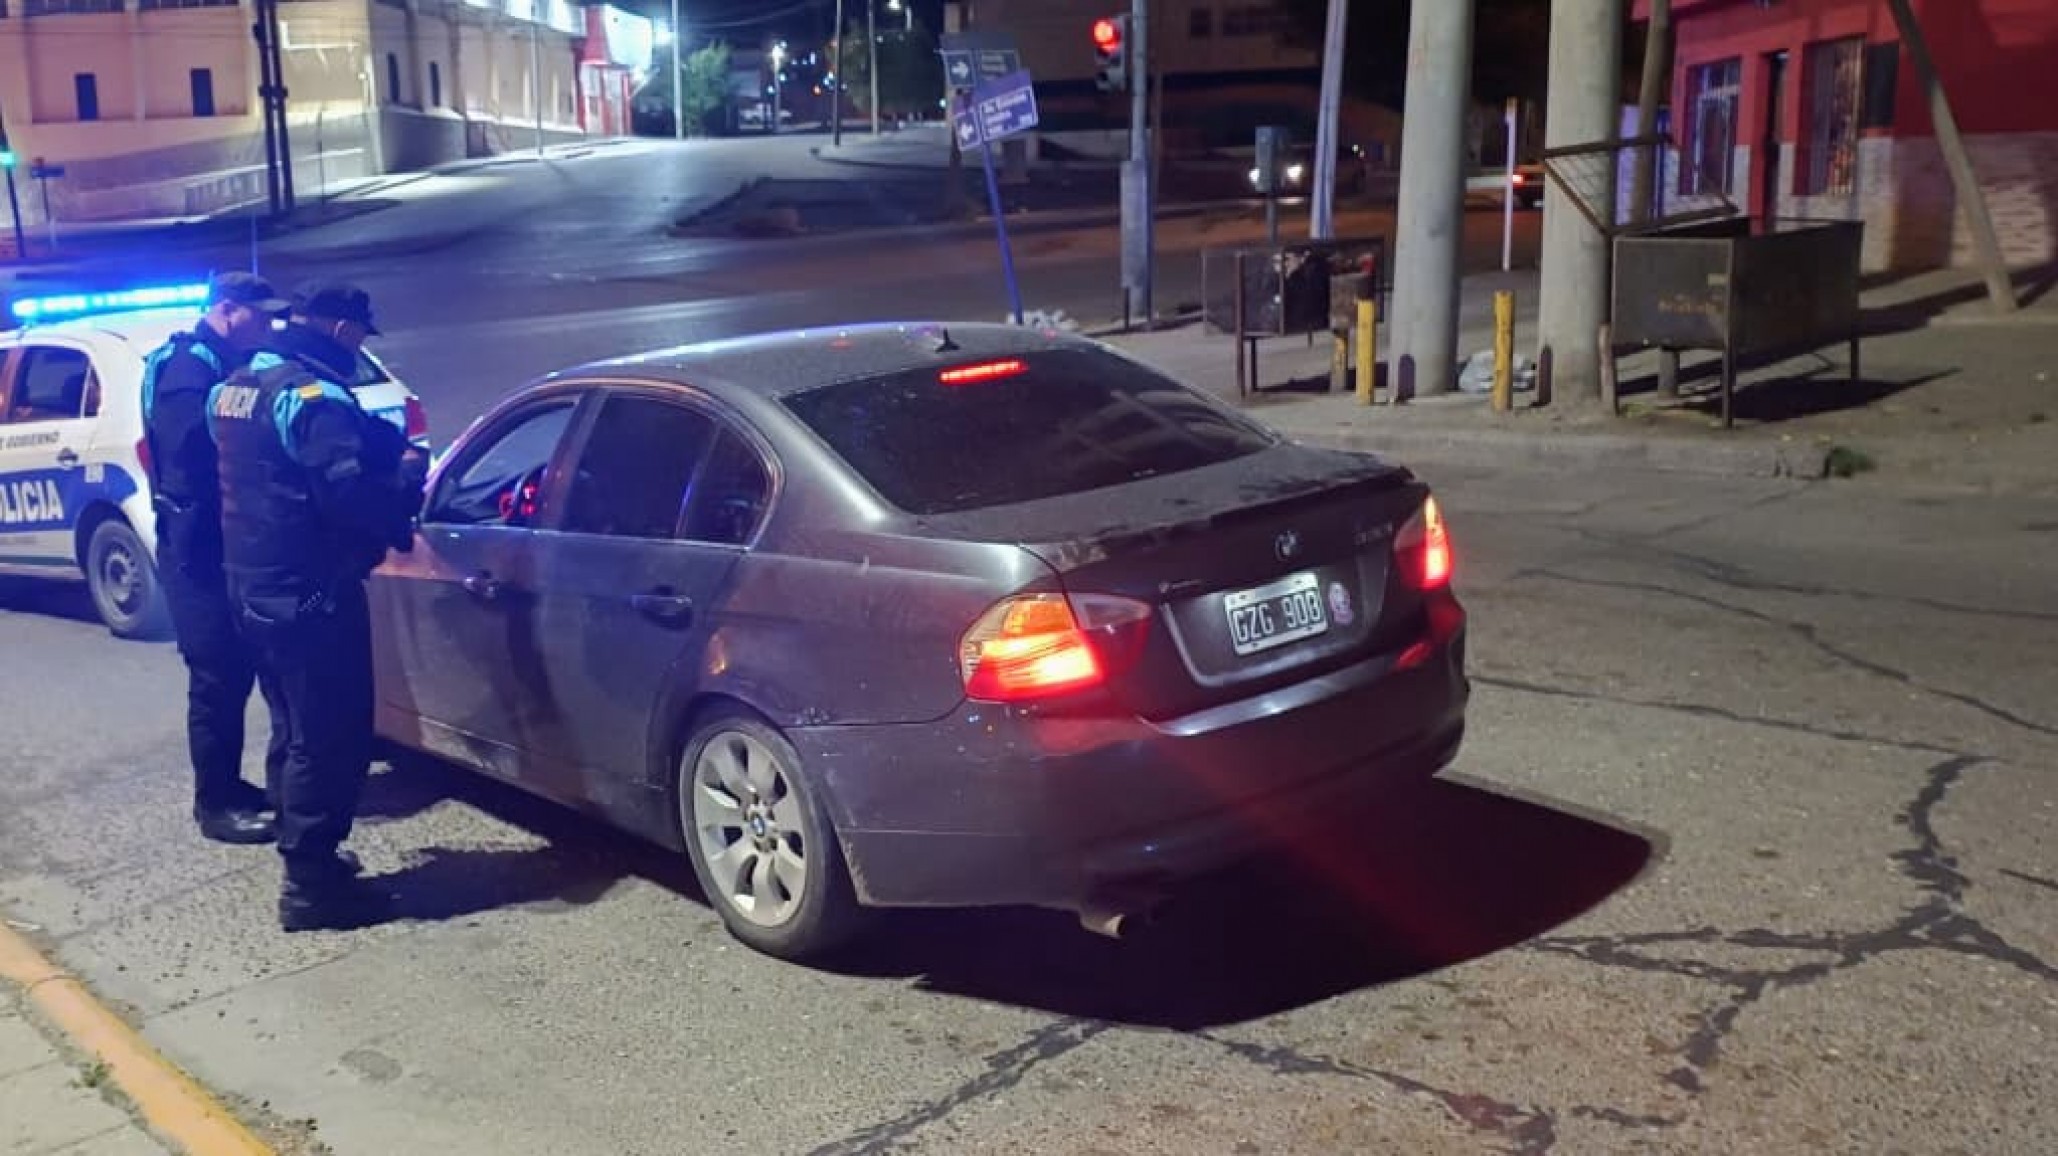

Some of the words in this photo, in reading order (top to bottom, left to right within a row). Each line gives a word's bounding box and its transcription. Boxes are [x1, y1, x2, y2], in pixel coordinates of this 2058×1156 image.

[216, 385, 260, 418] POLICIA
[1232, 603, 1275, 642] GZG
[1281, 589, 1322, 628] 908
